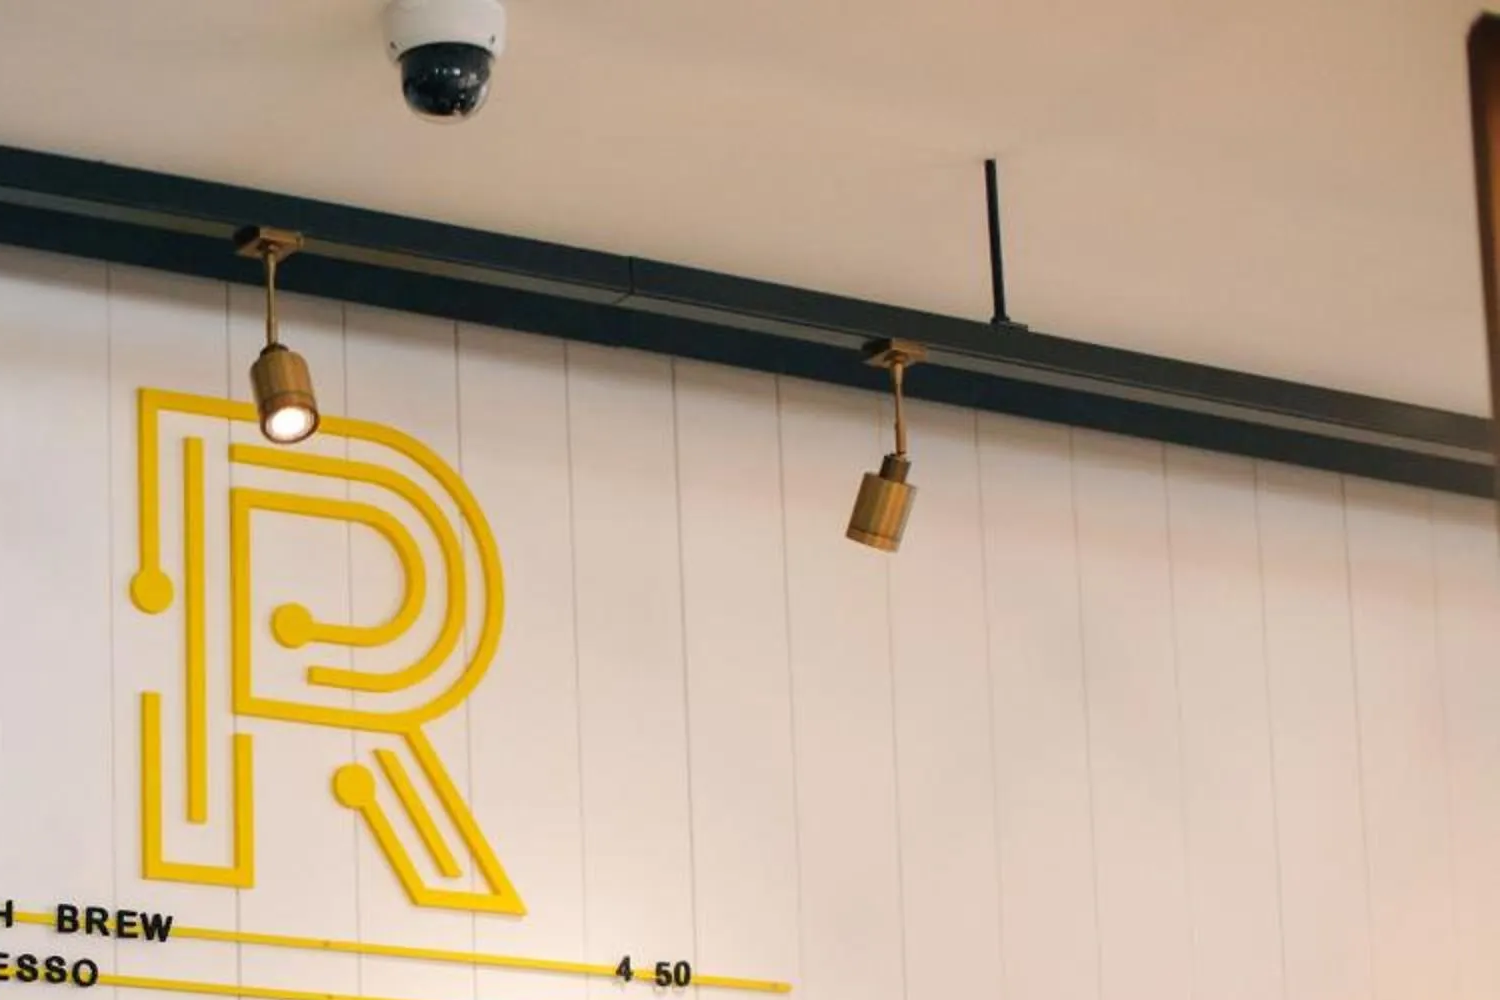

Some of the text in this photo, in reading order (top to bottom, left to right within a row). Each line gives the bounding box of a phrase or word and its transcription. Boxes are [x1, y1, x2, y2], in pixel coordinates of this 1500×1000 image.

[56, 903, 173, 943] BREW
[615, 956, 633, 982] 4
[655, 961, 691, 987] 50
